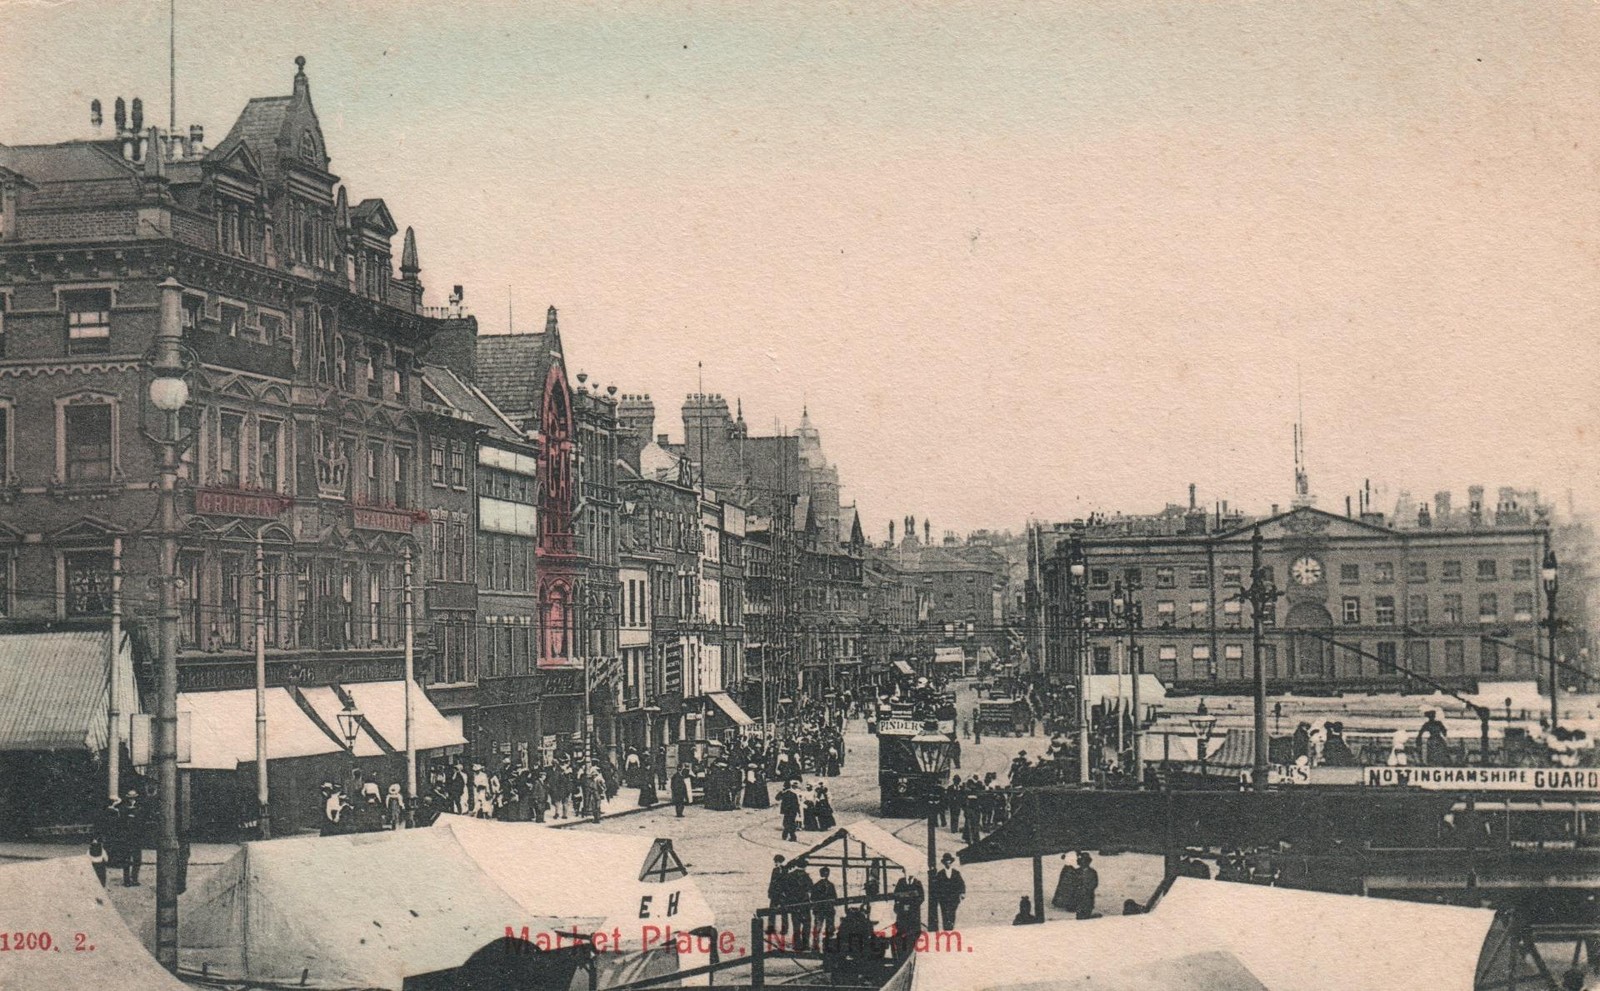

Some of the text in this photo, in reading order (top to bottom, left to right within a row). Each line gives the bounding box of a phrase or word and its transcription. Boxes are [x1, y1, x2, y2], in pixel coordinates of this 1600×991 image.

[202, 493, 273, 517] GRIFFIN
[1369, 769, 1599, 788] NOTTINGHAMSHIRE GUARD
